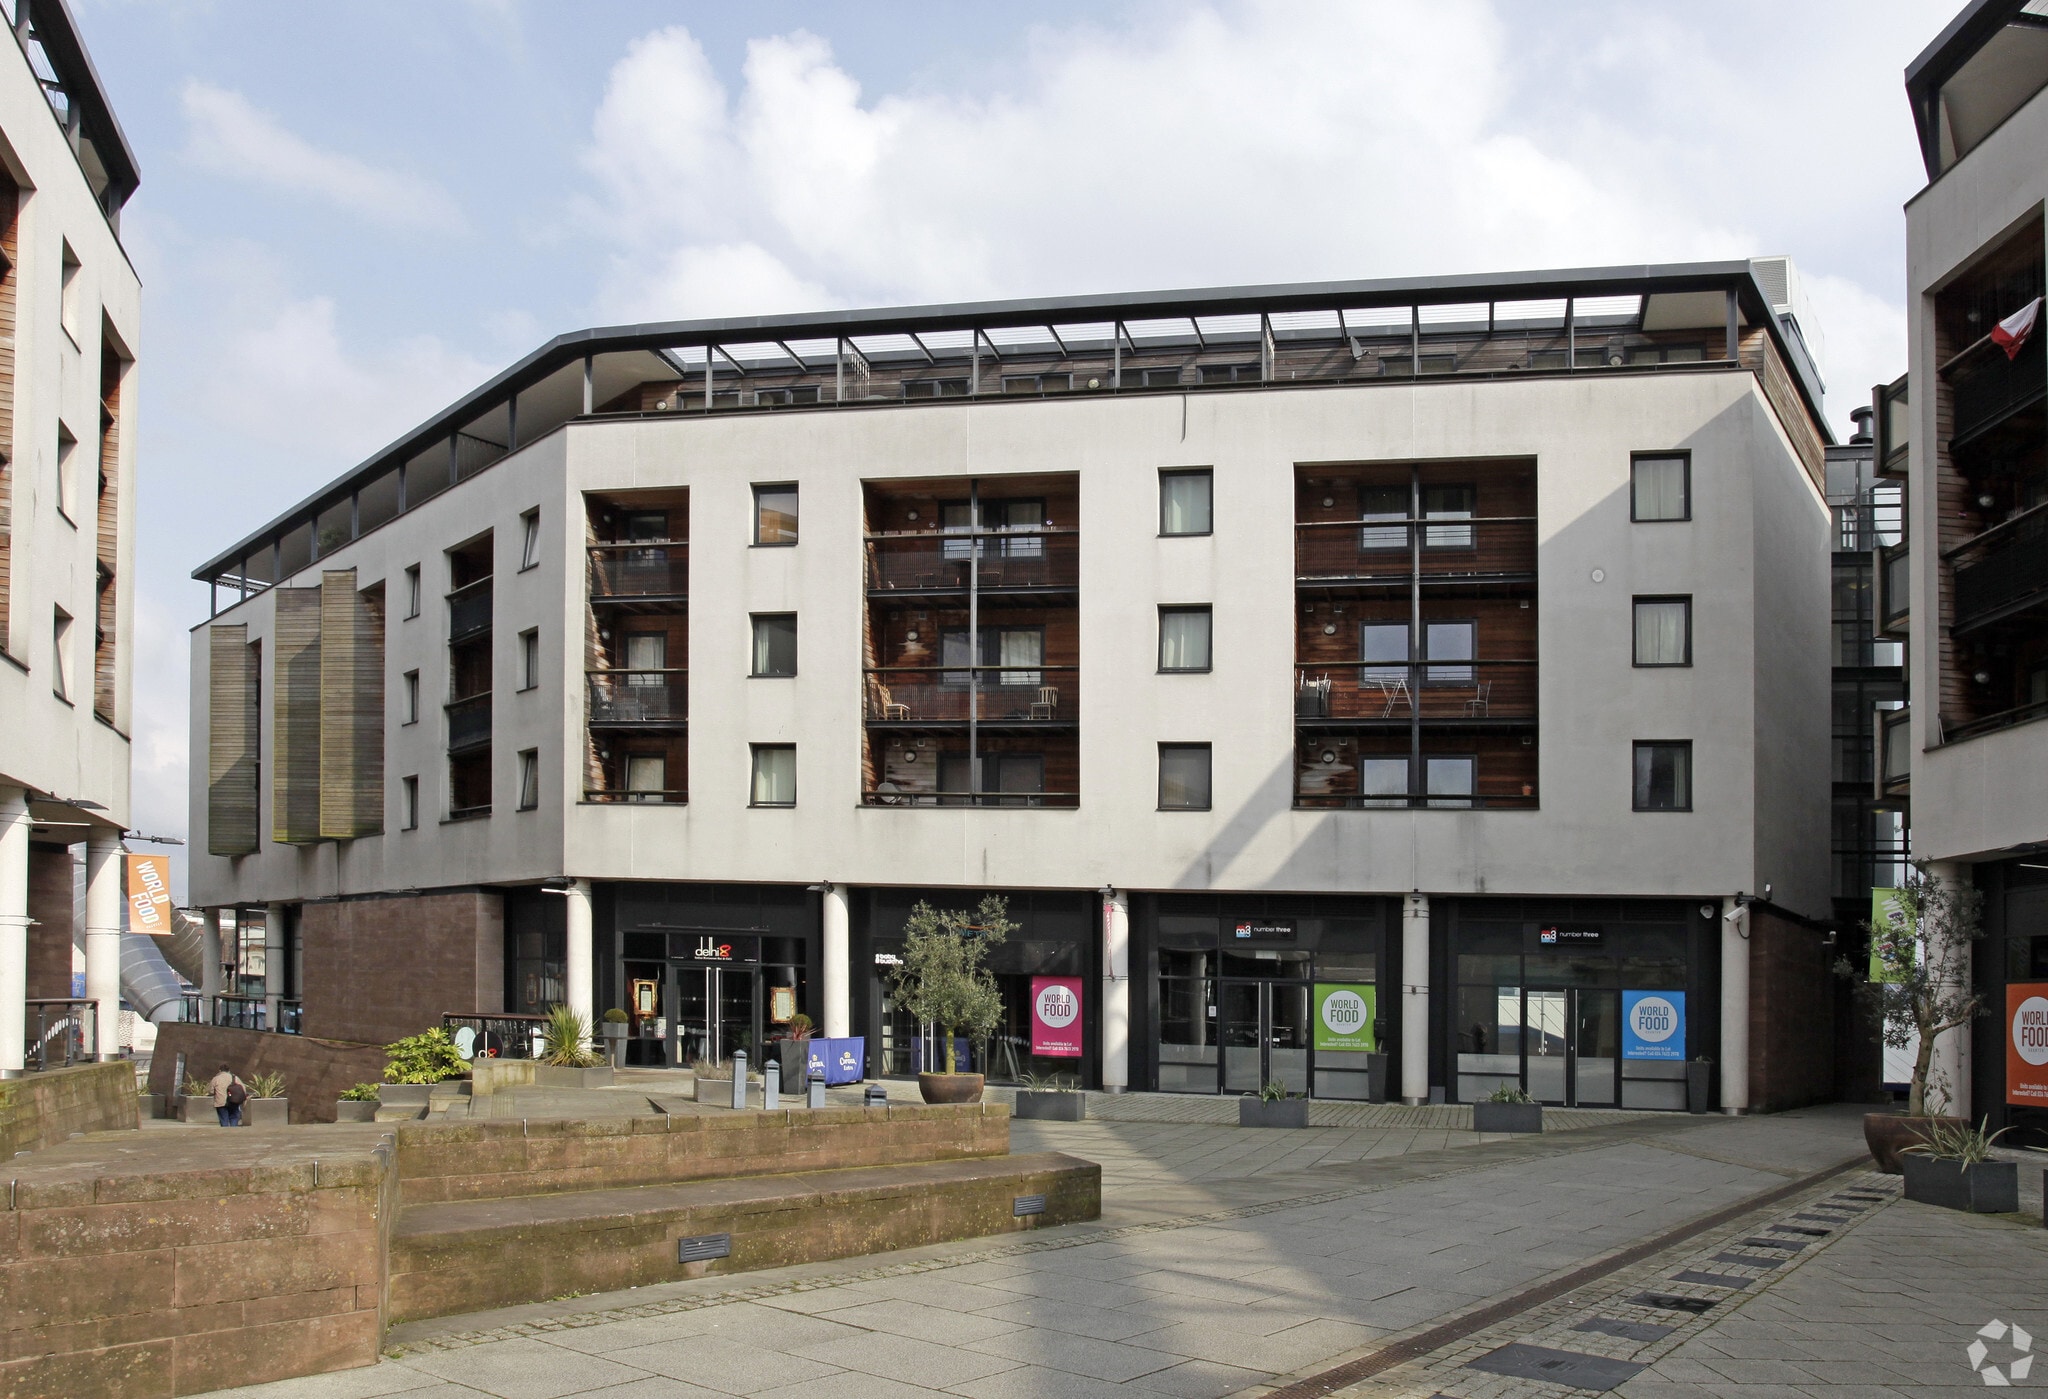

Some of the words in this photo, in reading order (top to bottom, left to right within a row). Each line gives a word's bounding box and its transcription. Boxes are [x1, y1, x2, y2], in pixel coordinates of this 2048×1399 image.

[136, 860, 170, 904] WORLD
[131, 891, 159, 924] FOOD
[1044, 993, 1070, 1004] WORLD
[1330, 999, 1359, 1009] WORLD
[1044, 1003, 1070, 1017] FOOD
[1330, 1009, 1359, 1023] FOOD
[1639, 1006, 1669, 1016] WORLD
[1639, 1016, 1669, 1030] FOOD
[2021, 1010, 2048, 1026] WORL
[808, 1060, 825, 1069] Corona
[840, 1057, 857, 1066] Corona
